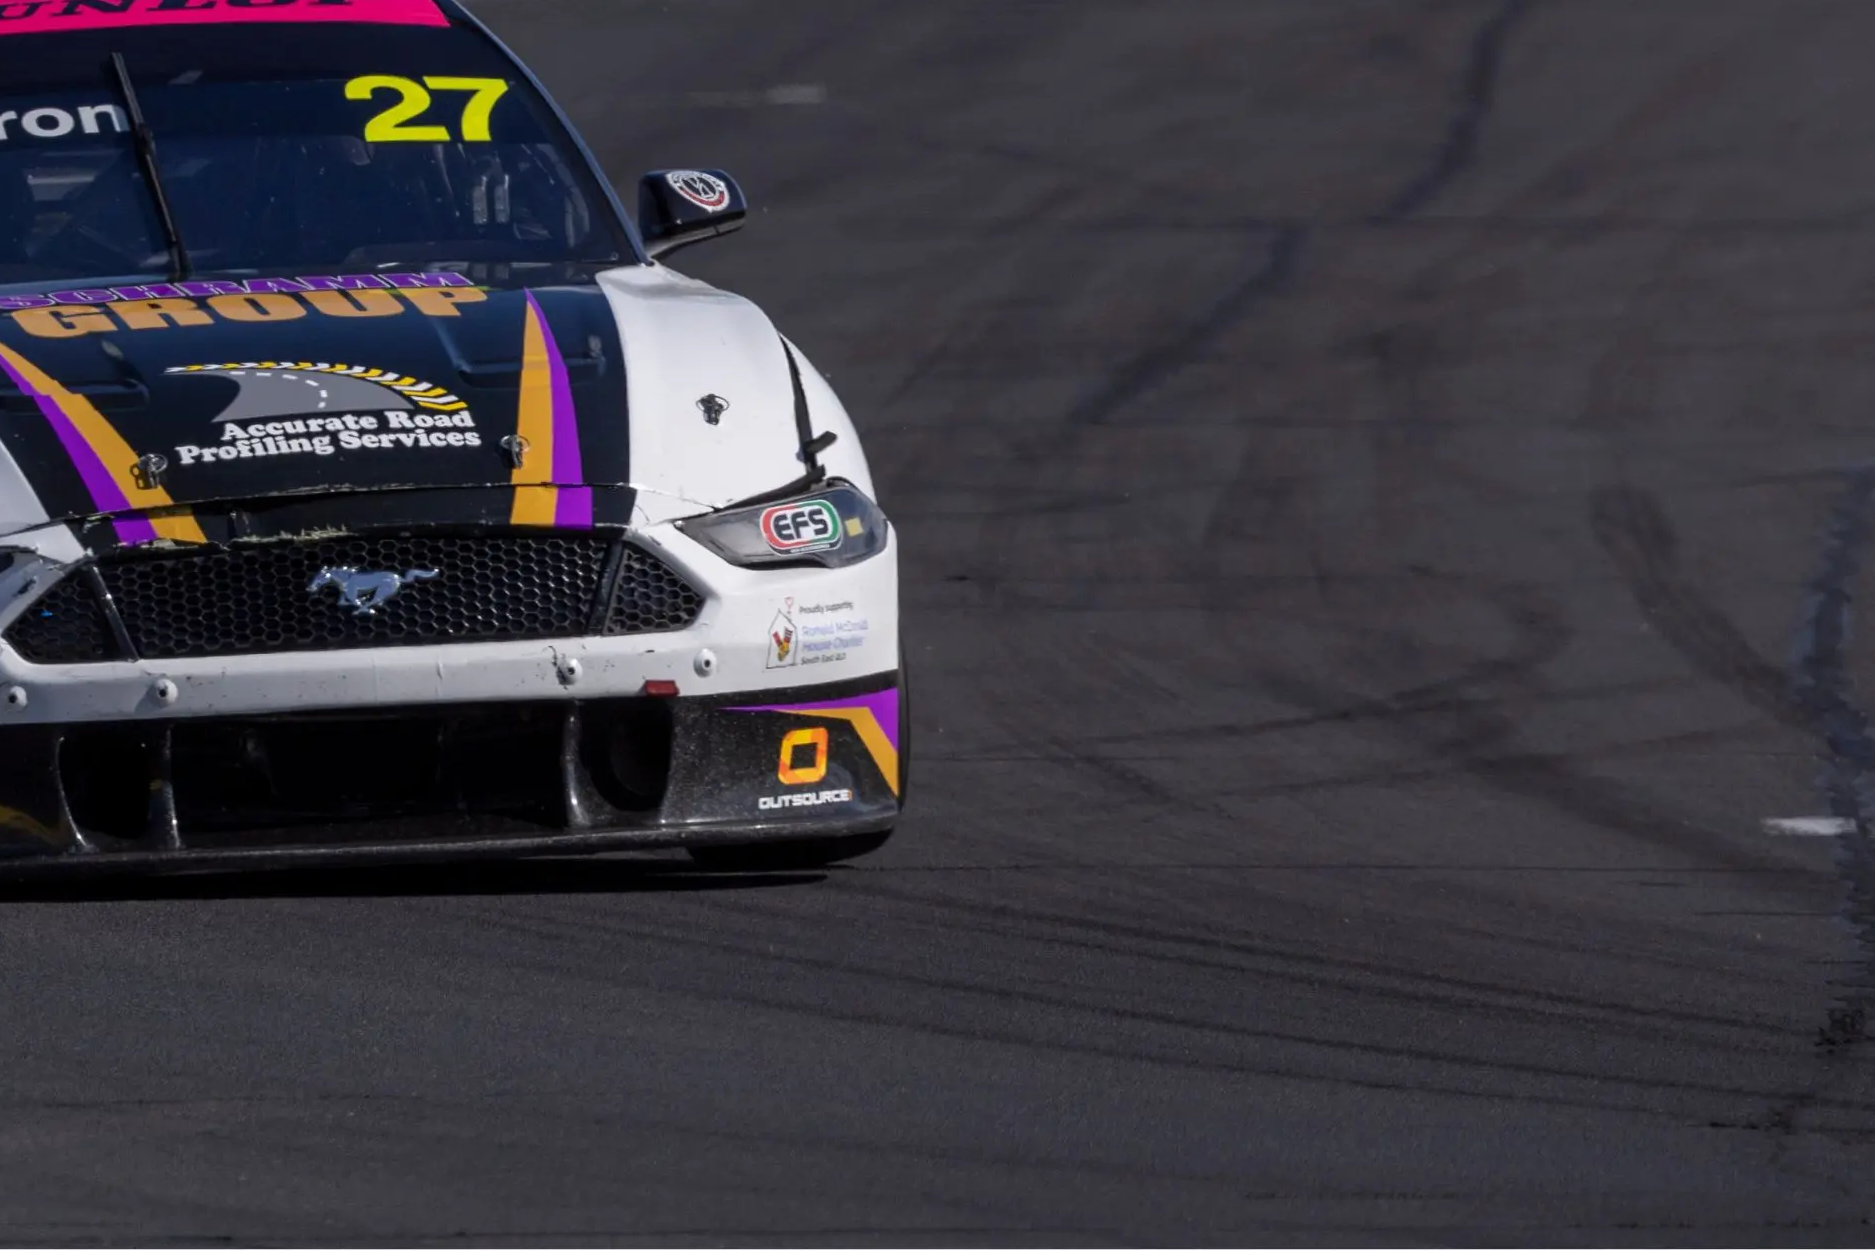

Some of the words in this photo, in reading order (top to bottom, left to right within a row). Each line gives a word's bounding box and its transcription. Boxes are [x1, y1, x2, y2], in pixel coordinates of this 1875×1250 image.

[344, 74, 509, 142] 27
[11, 287, 488, 338] GROUP
[221, 414, 378, 440] Accurate
[384, 410, 475, 429] Road
[175, 434, 335, 464] Profiling
[337, 429, 482, 449] Services
[773, 508, 829, 541] EFS
